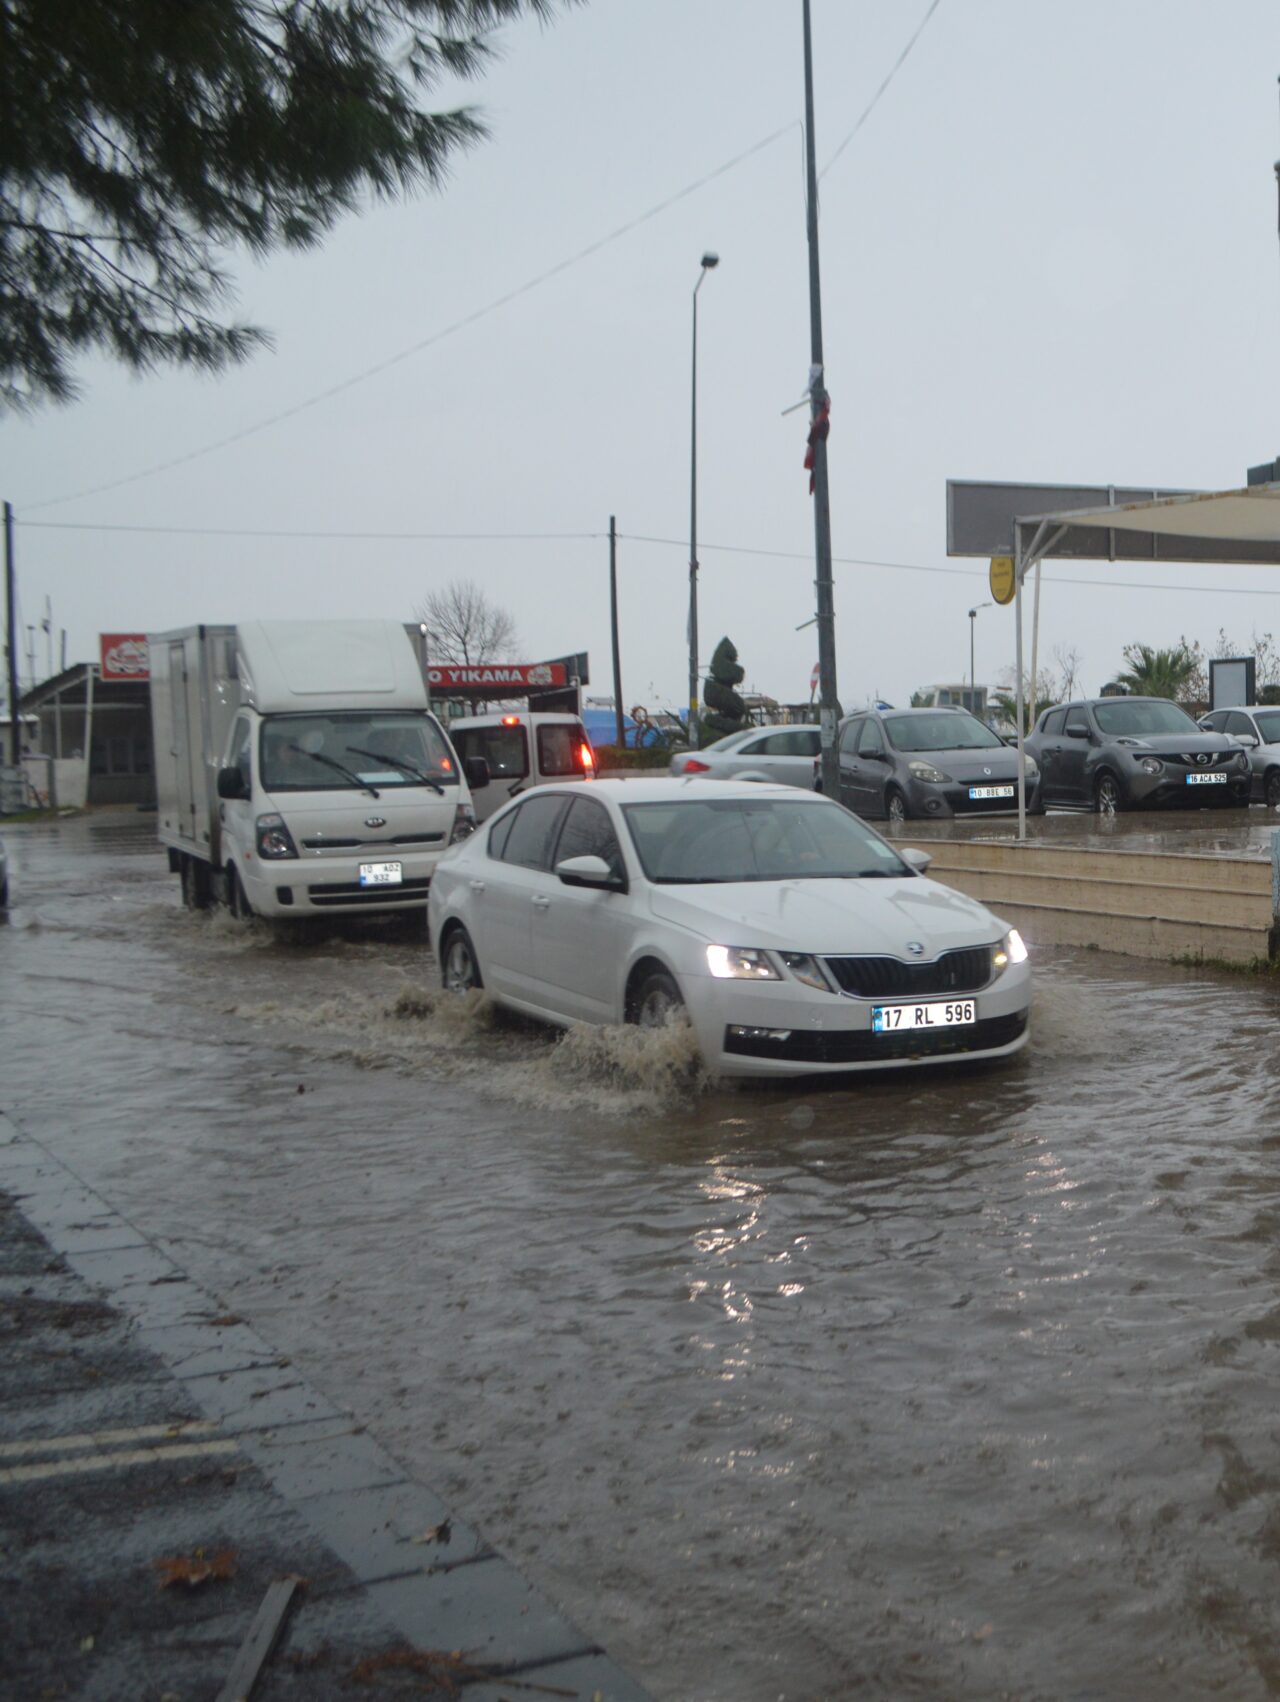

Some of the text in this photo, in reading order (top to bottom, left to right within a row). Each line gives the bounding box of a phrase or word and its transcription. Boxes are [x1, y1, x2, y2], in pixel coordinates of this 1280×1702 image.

[448, 669, 524, 683] YIKAMA
[884, 1003, 972, 1028] 17 RL 596
